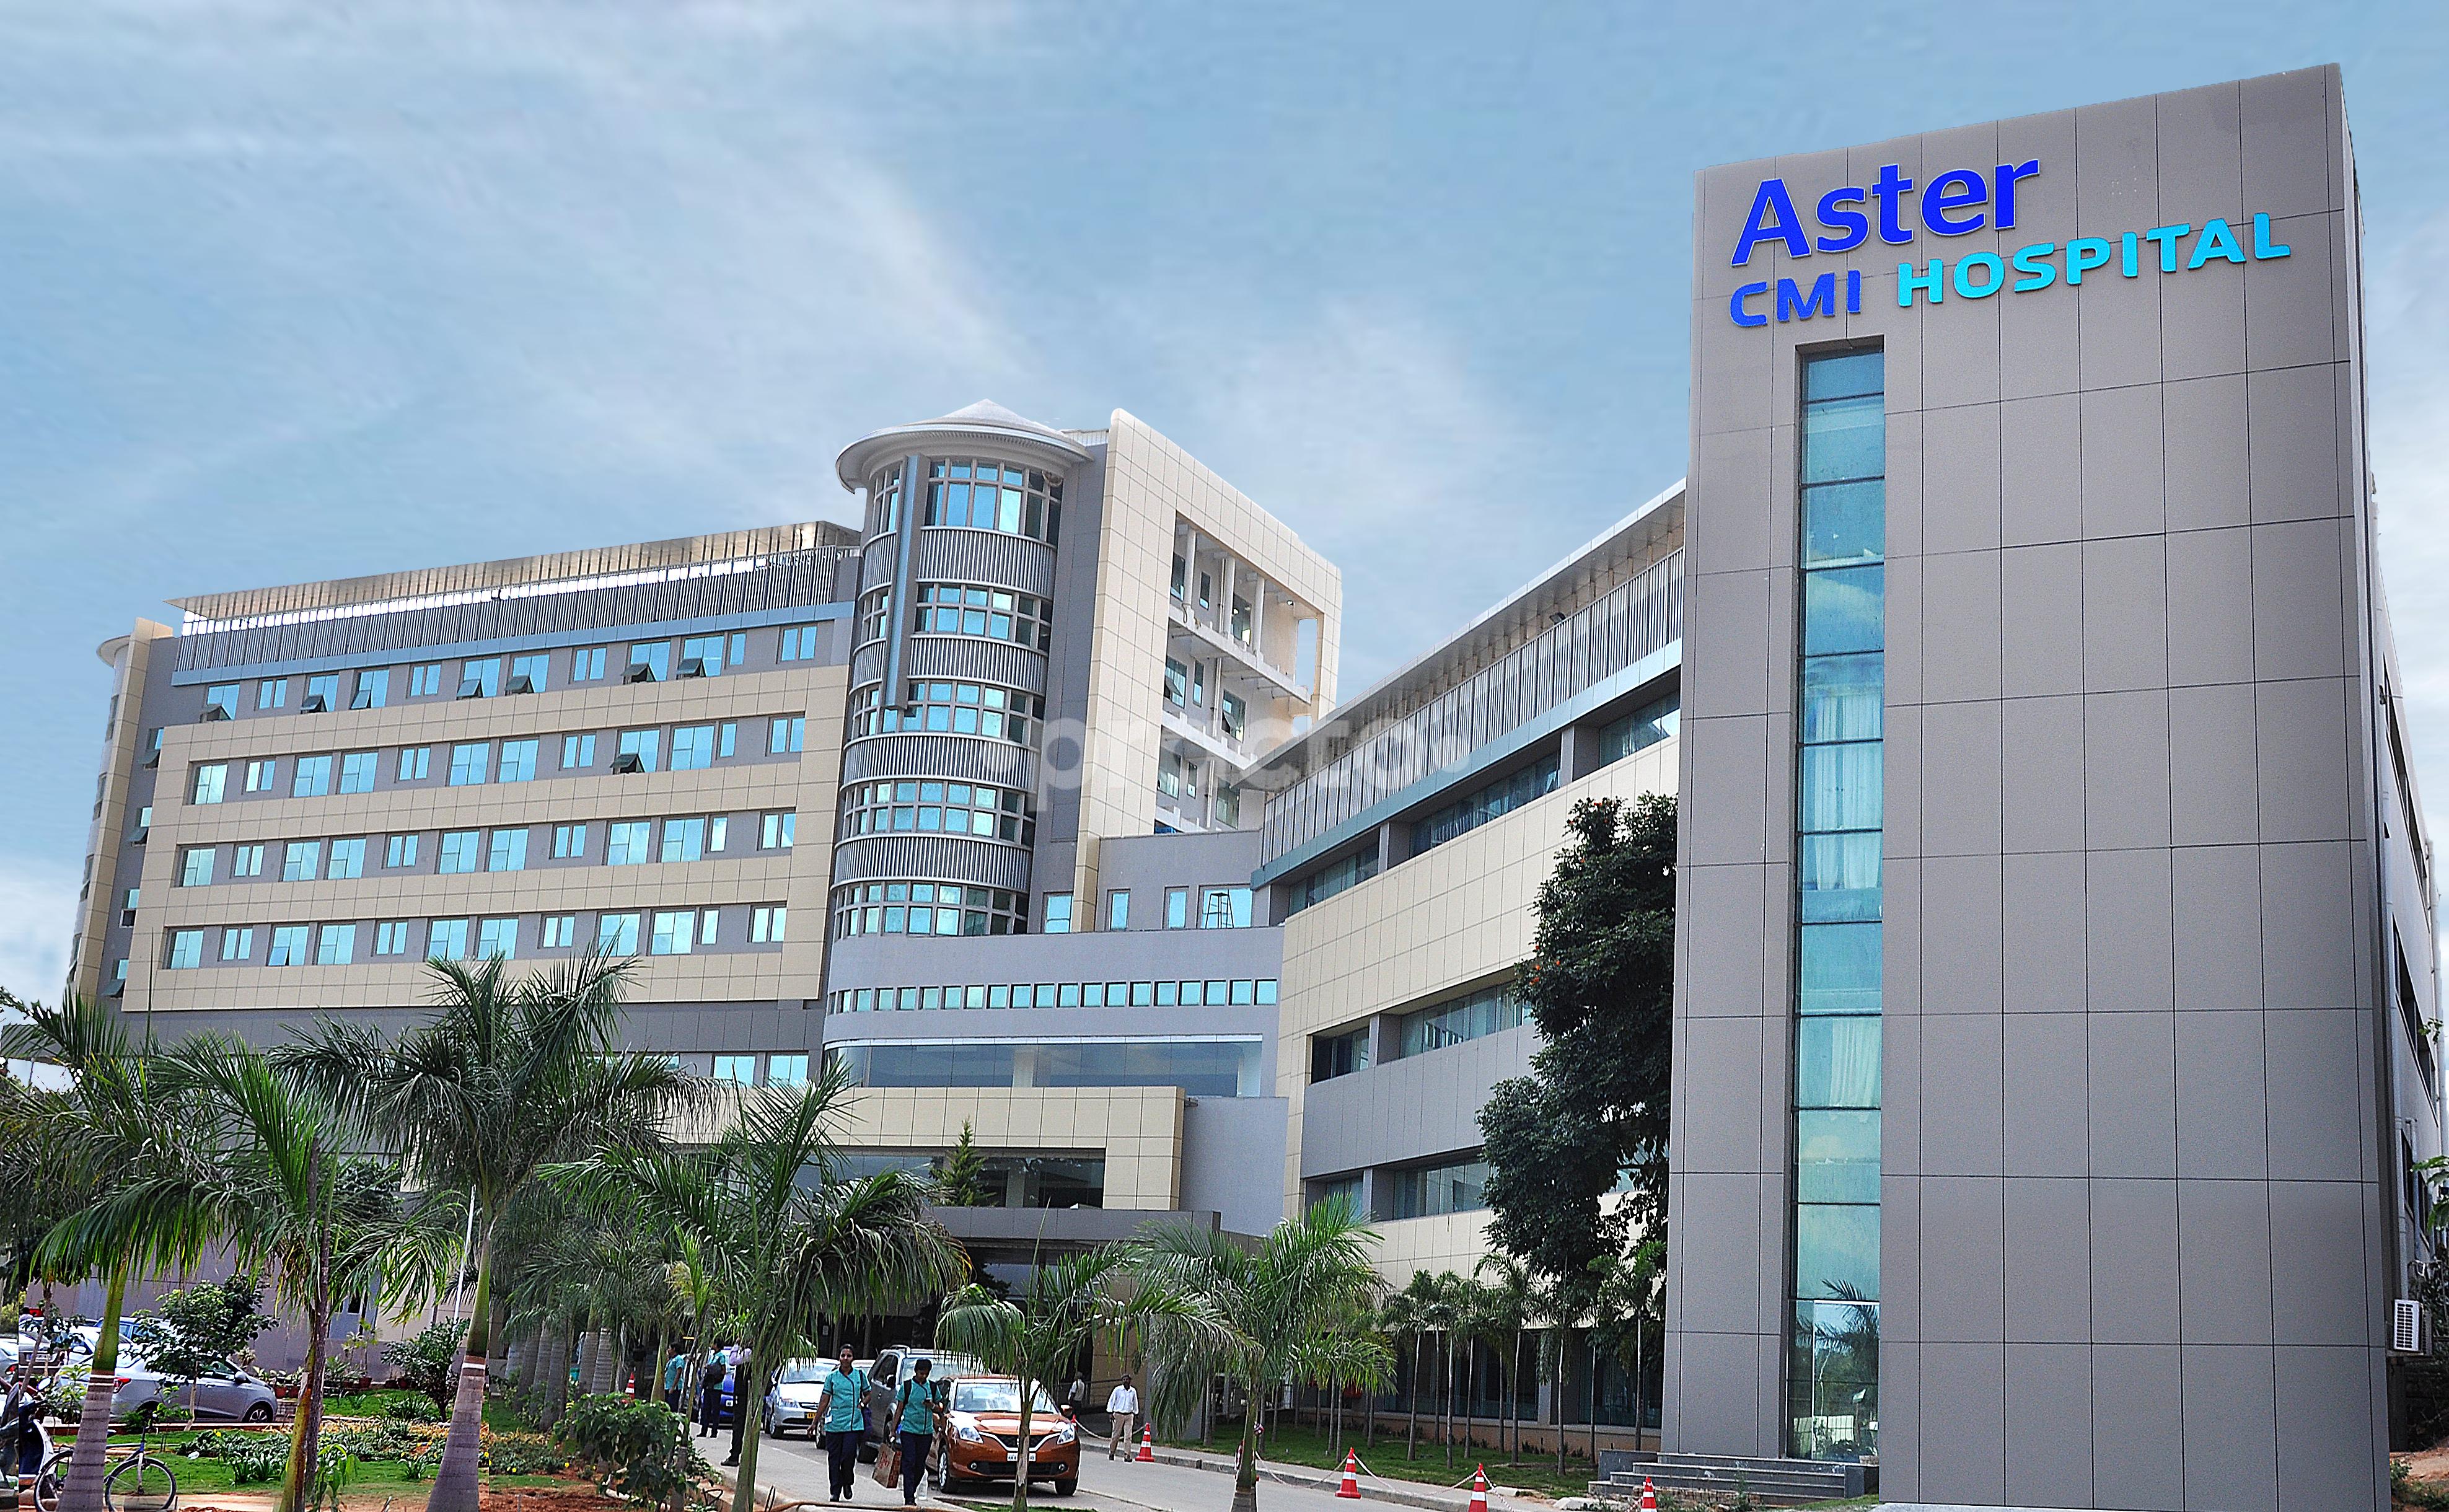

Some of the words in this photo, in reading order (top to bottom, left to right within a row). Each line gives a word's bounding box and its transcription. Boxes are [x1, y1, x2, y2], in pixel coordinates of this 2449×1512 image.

[1731, 159, 2039, 266] Aster
[1730, 270, 1862, 328] CMI
[1897, 212, 2292, 308] HOSPITAL
